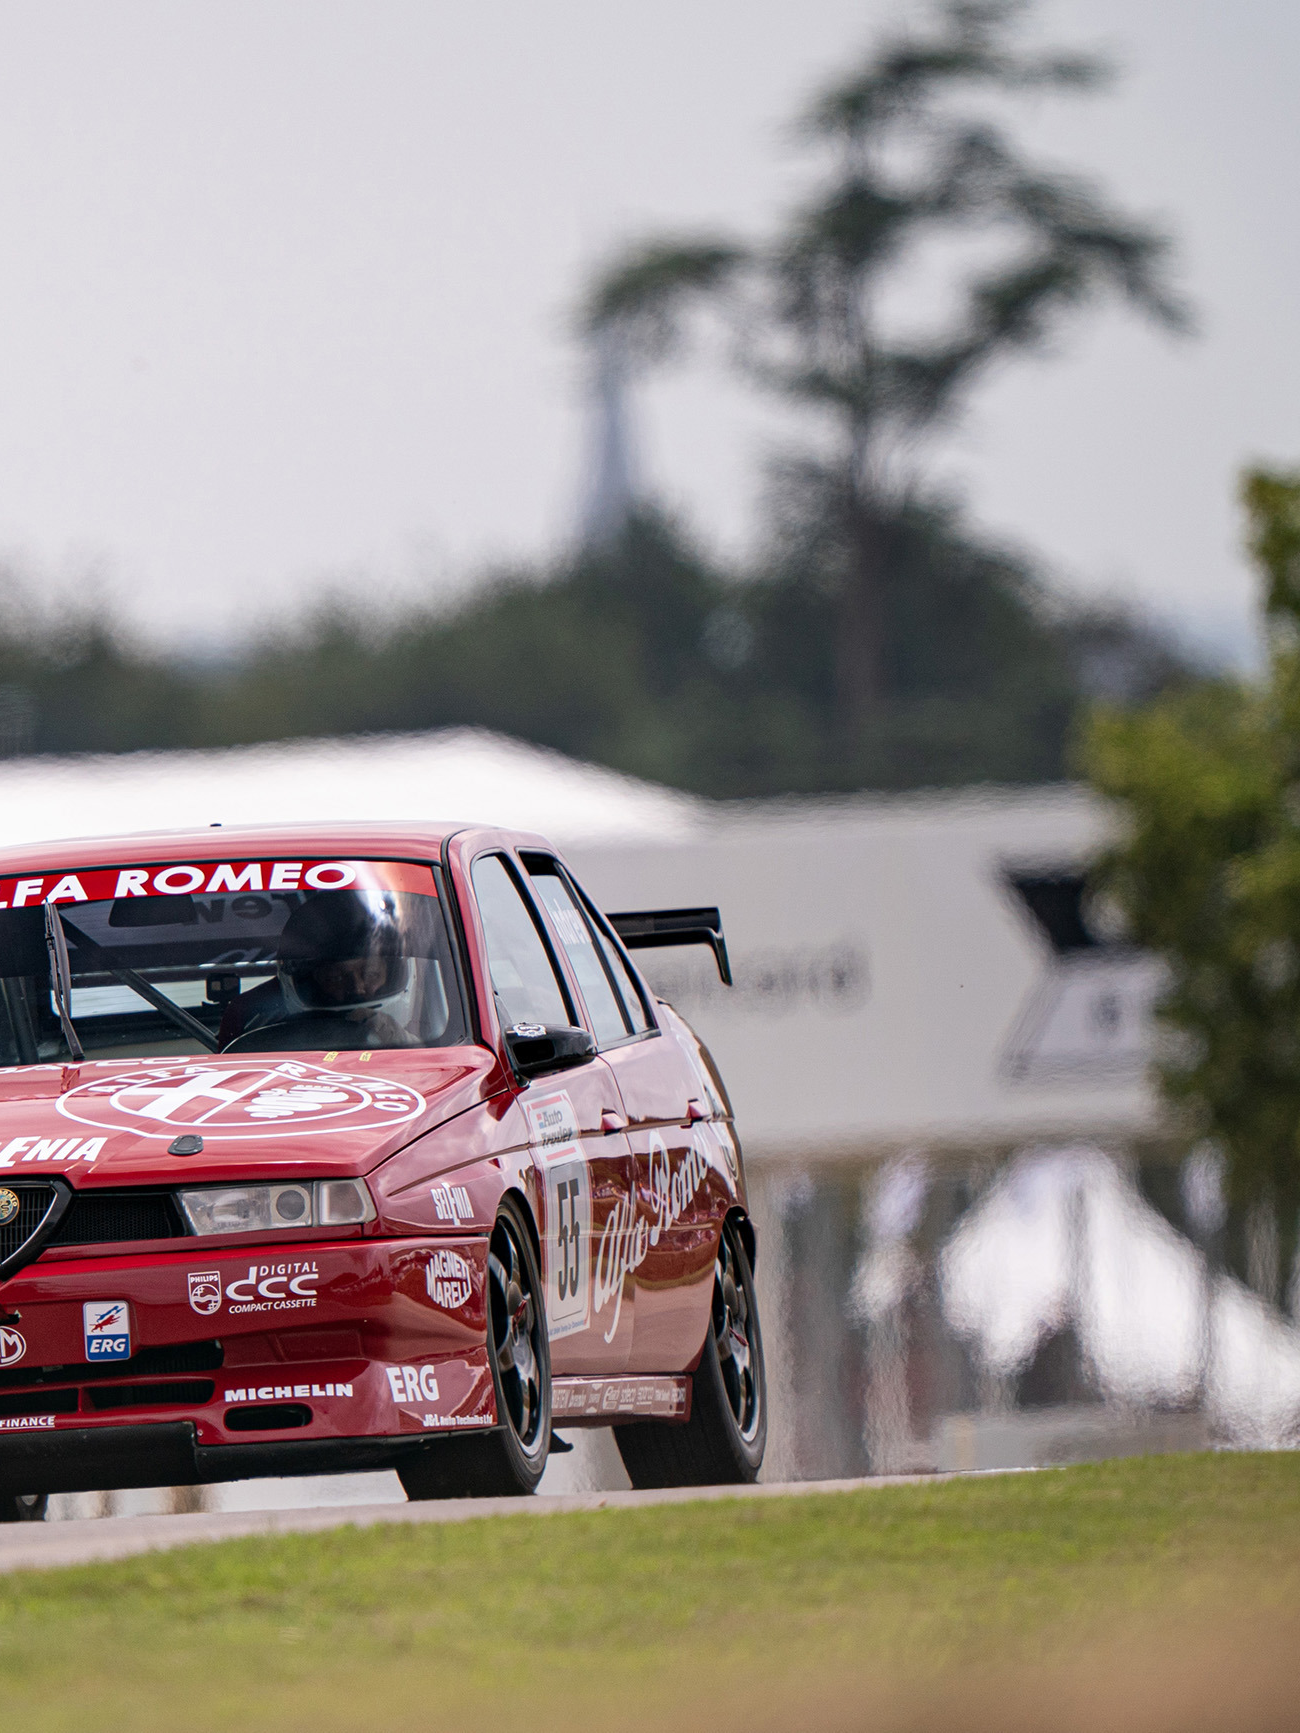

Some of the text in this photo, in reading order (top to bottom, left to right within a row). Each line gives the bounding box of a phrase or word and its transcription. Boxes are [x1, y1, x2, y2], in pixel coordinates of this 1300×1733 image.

[113, 862, 357, 899] ROMEO
[87, 1062, 412, 1113] ALFA ROMEO
[542, 1109, 563, 1127] Auto
[430, 1182, 475, 1226] SELENIA
[557, 1178, 580, 1301] 55
[259, 1261, 319, 1276] DIGITAL
[190, 1274, 219, 1283] PHILIPS
[228, 1298, 317, 1314] COMPACT CASSETTE
[90, 1338, 126, 1353] ERG
[385, 1364, 440, 1402] ERG
[225, 1383, 353, 1402] MICHELIN
[0, 1415, 56, 1427] FINANCE
